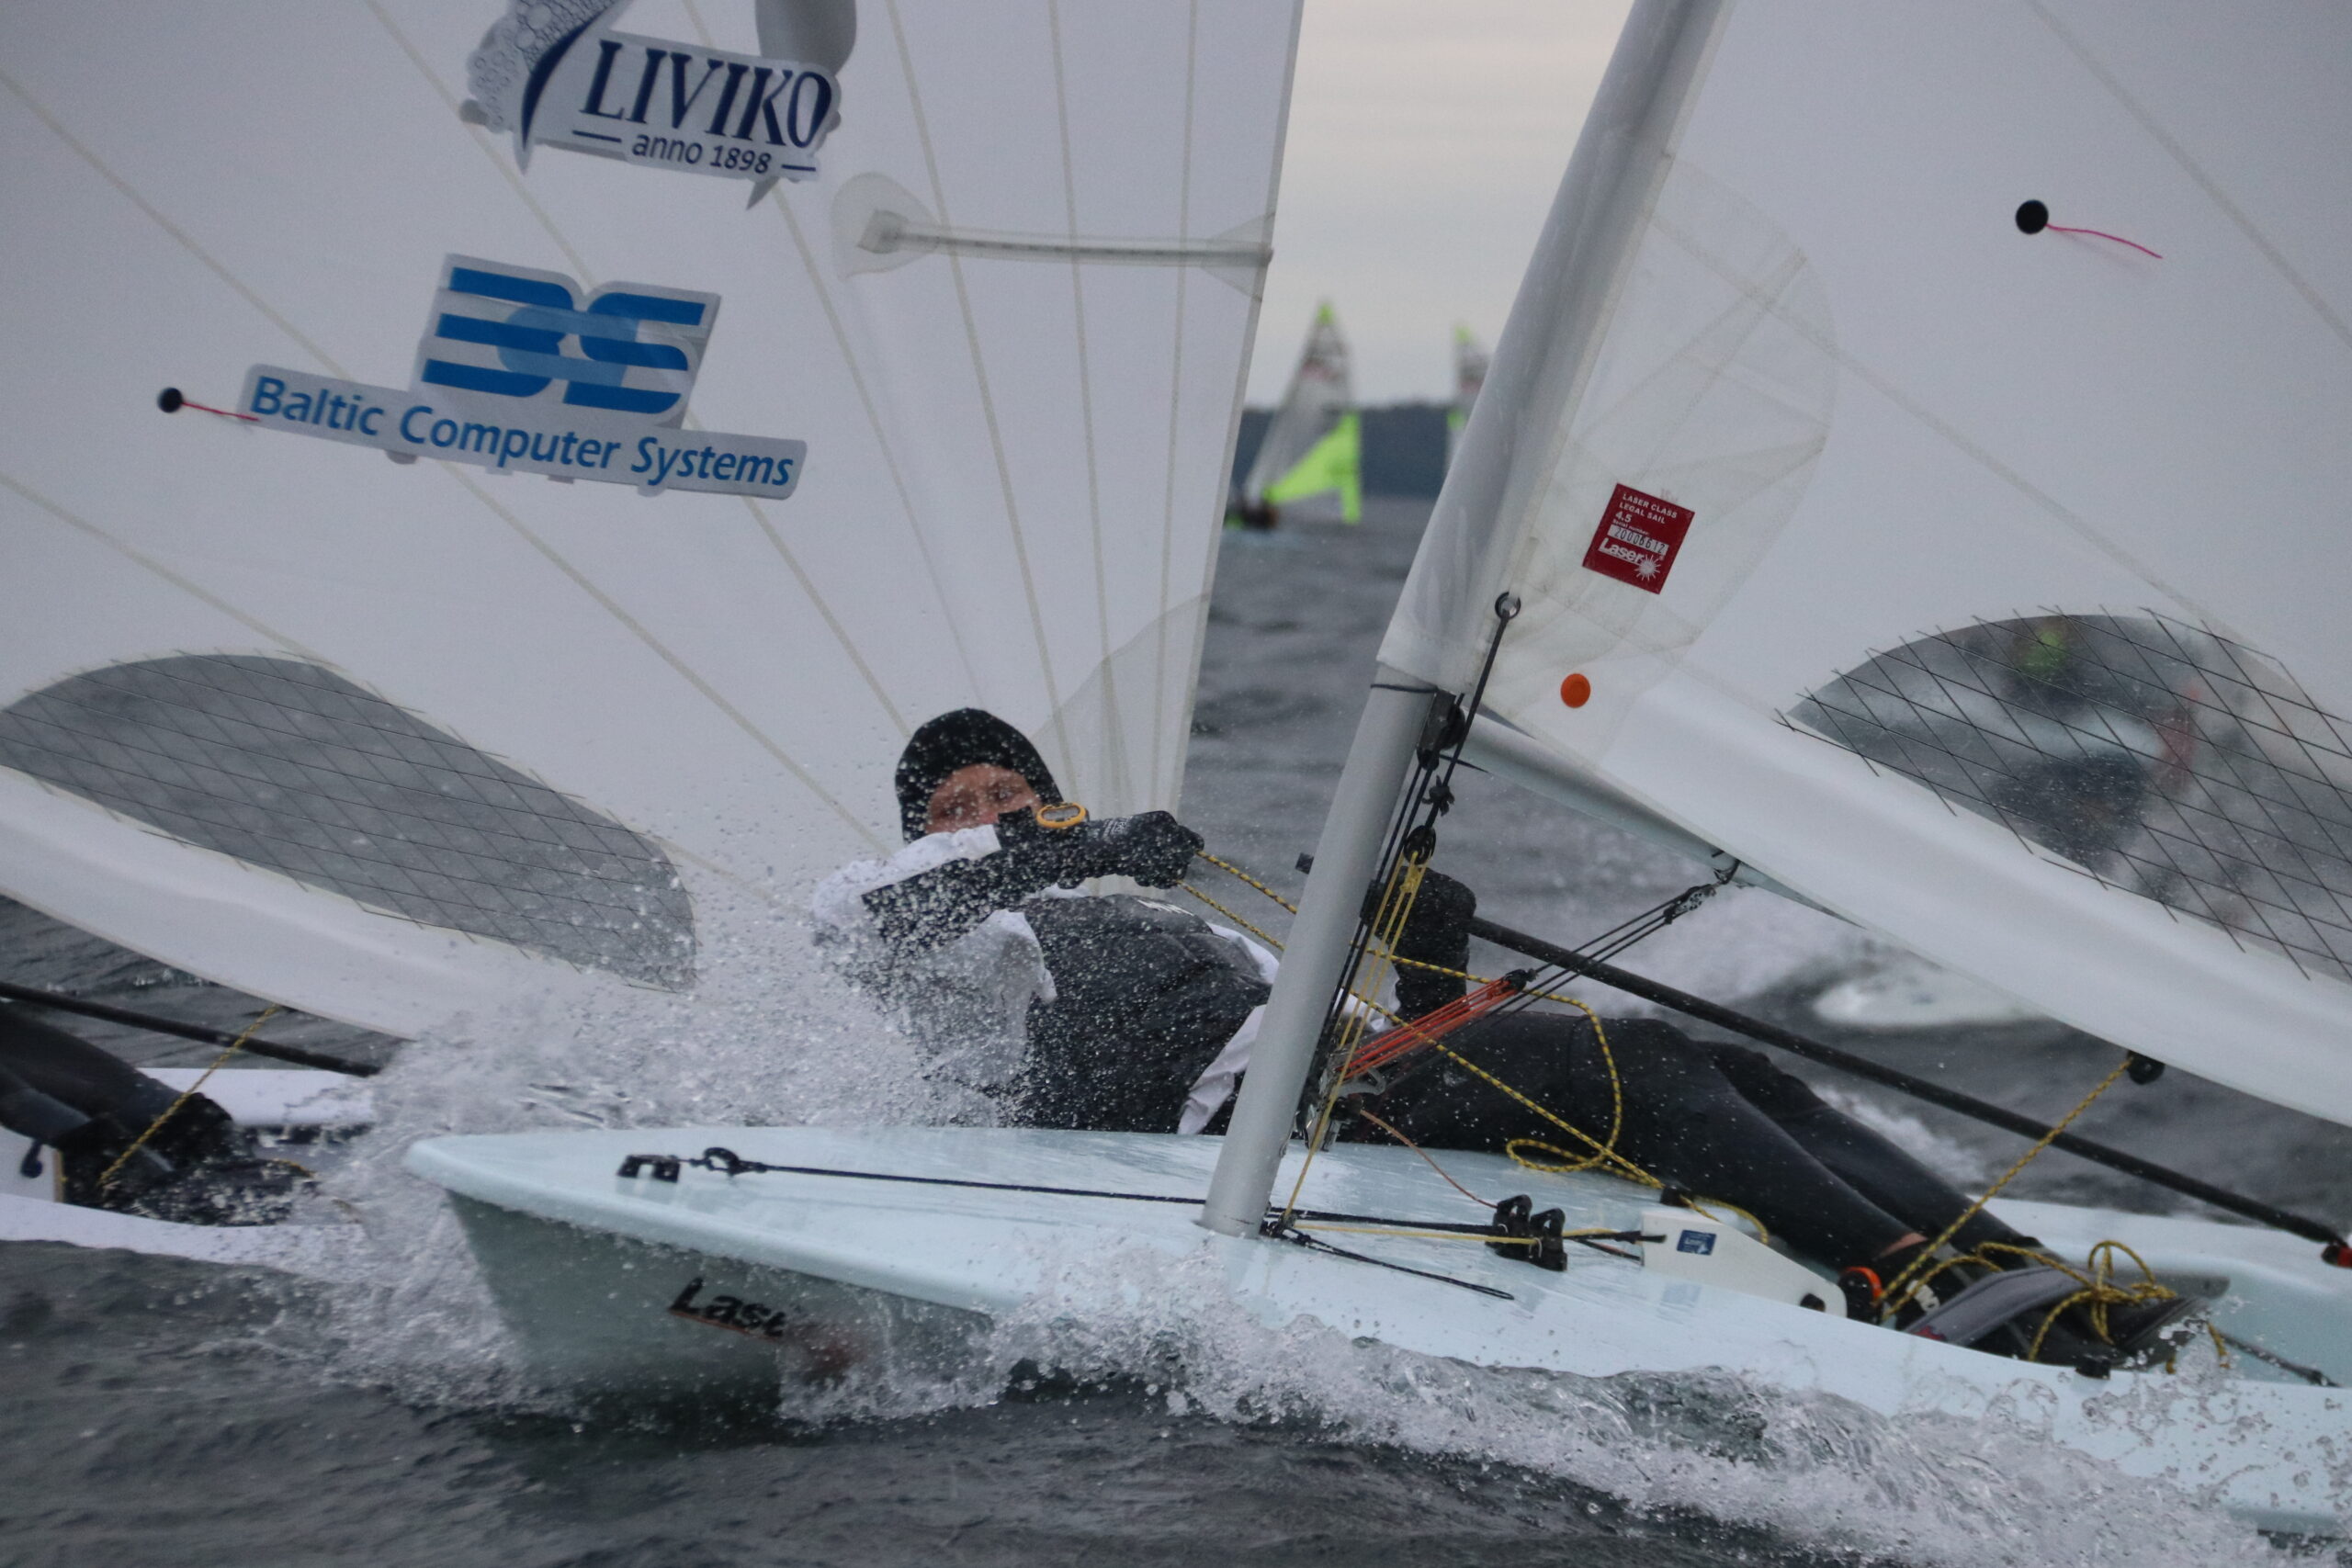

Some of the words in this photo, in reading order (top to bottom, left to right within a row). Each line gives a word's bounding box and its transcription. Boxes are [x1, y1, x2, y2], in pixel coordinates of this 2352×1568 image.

[579, 39, 832, 149] LIVIKO
[632, 134, 703, 165] anno
[709, 144, 772, 174] 1898
[250, 376, 384, 436] Baltic
[400, 405, 621, 469] Computer
[630, 436, 795, 487] Systems
[1615, 511, 1632, 524] 4.5
[1619, 502, 1645, 516] LEGAL
[1647, 513, 1666, 524] SAIL
[1623, 493, 1649, 508] LASER
[1650, 503, 1678, 518] CLASS
[1599, 537, 1645, 565] Laser
